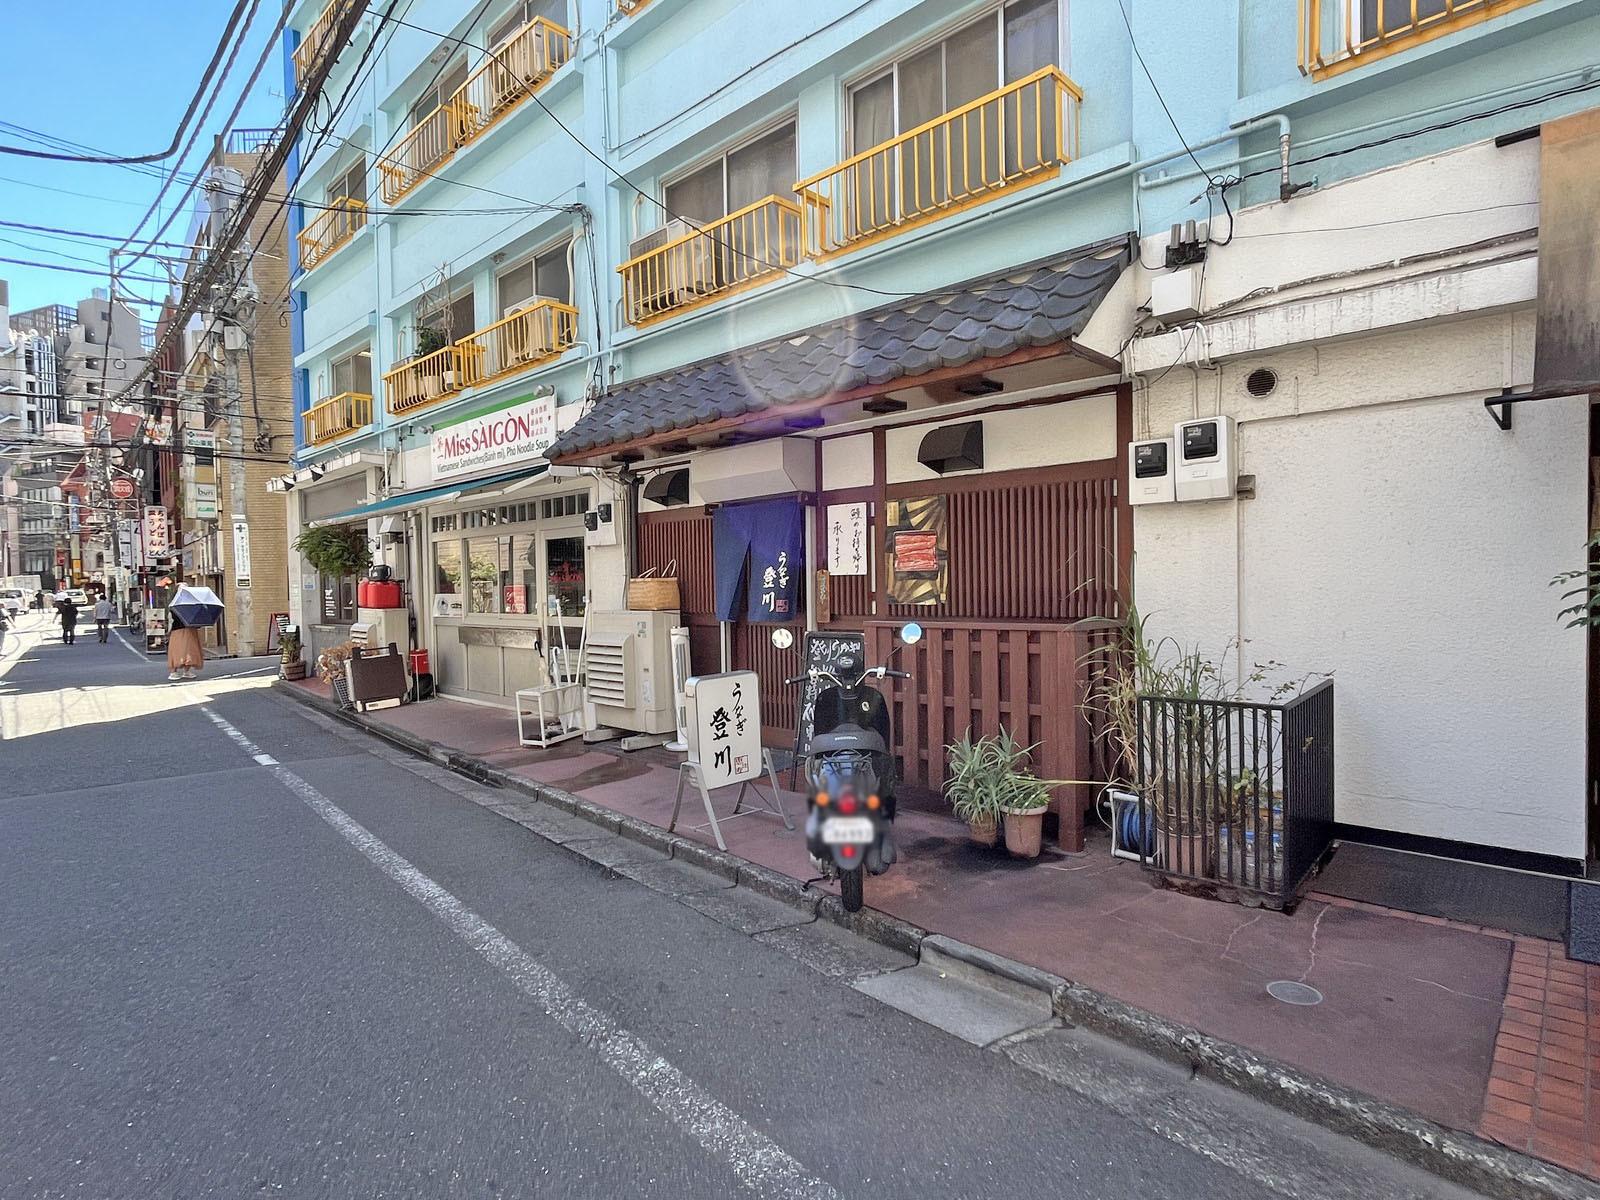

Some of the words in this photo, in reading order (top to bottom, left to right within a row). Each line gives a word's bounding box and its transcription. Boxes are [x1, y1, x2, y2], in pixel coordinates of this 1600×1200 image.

[444, 433, 471, 459] Miss
[471, 412, 530, 453] SÀIGÒN
[517, 442, 535, 454] Noodle
[535, 439, 550, 450] Soup
[761, 566, 777, 612] 登川
[777, 551, 790, 589] うなぎ
[732, 682, 748, 737] うなぎ
[709, 706, 732, 777] 登川
